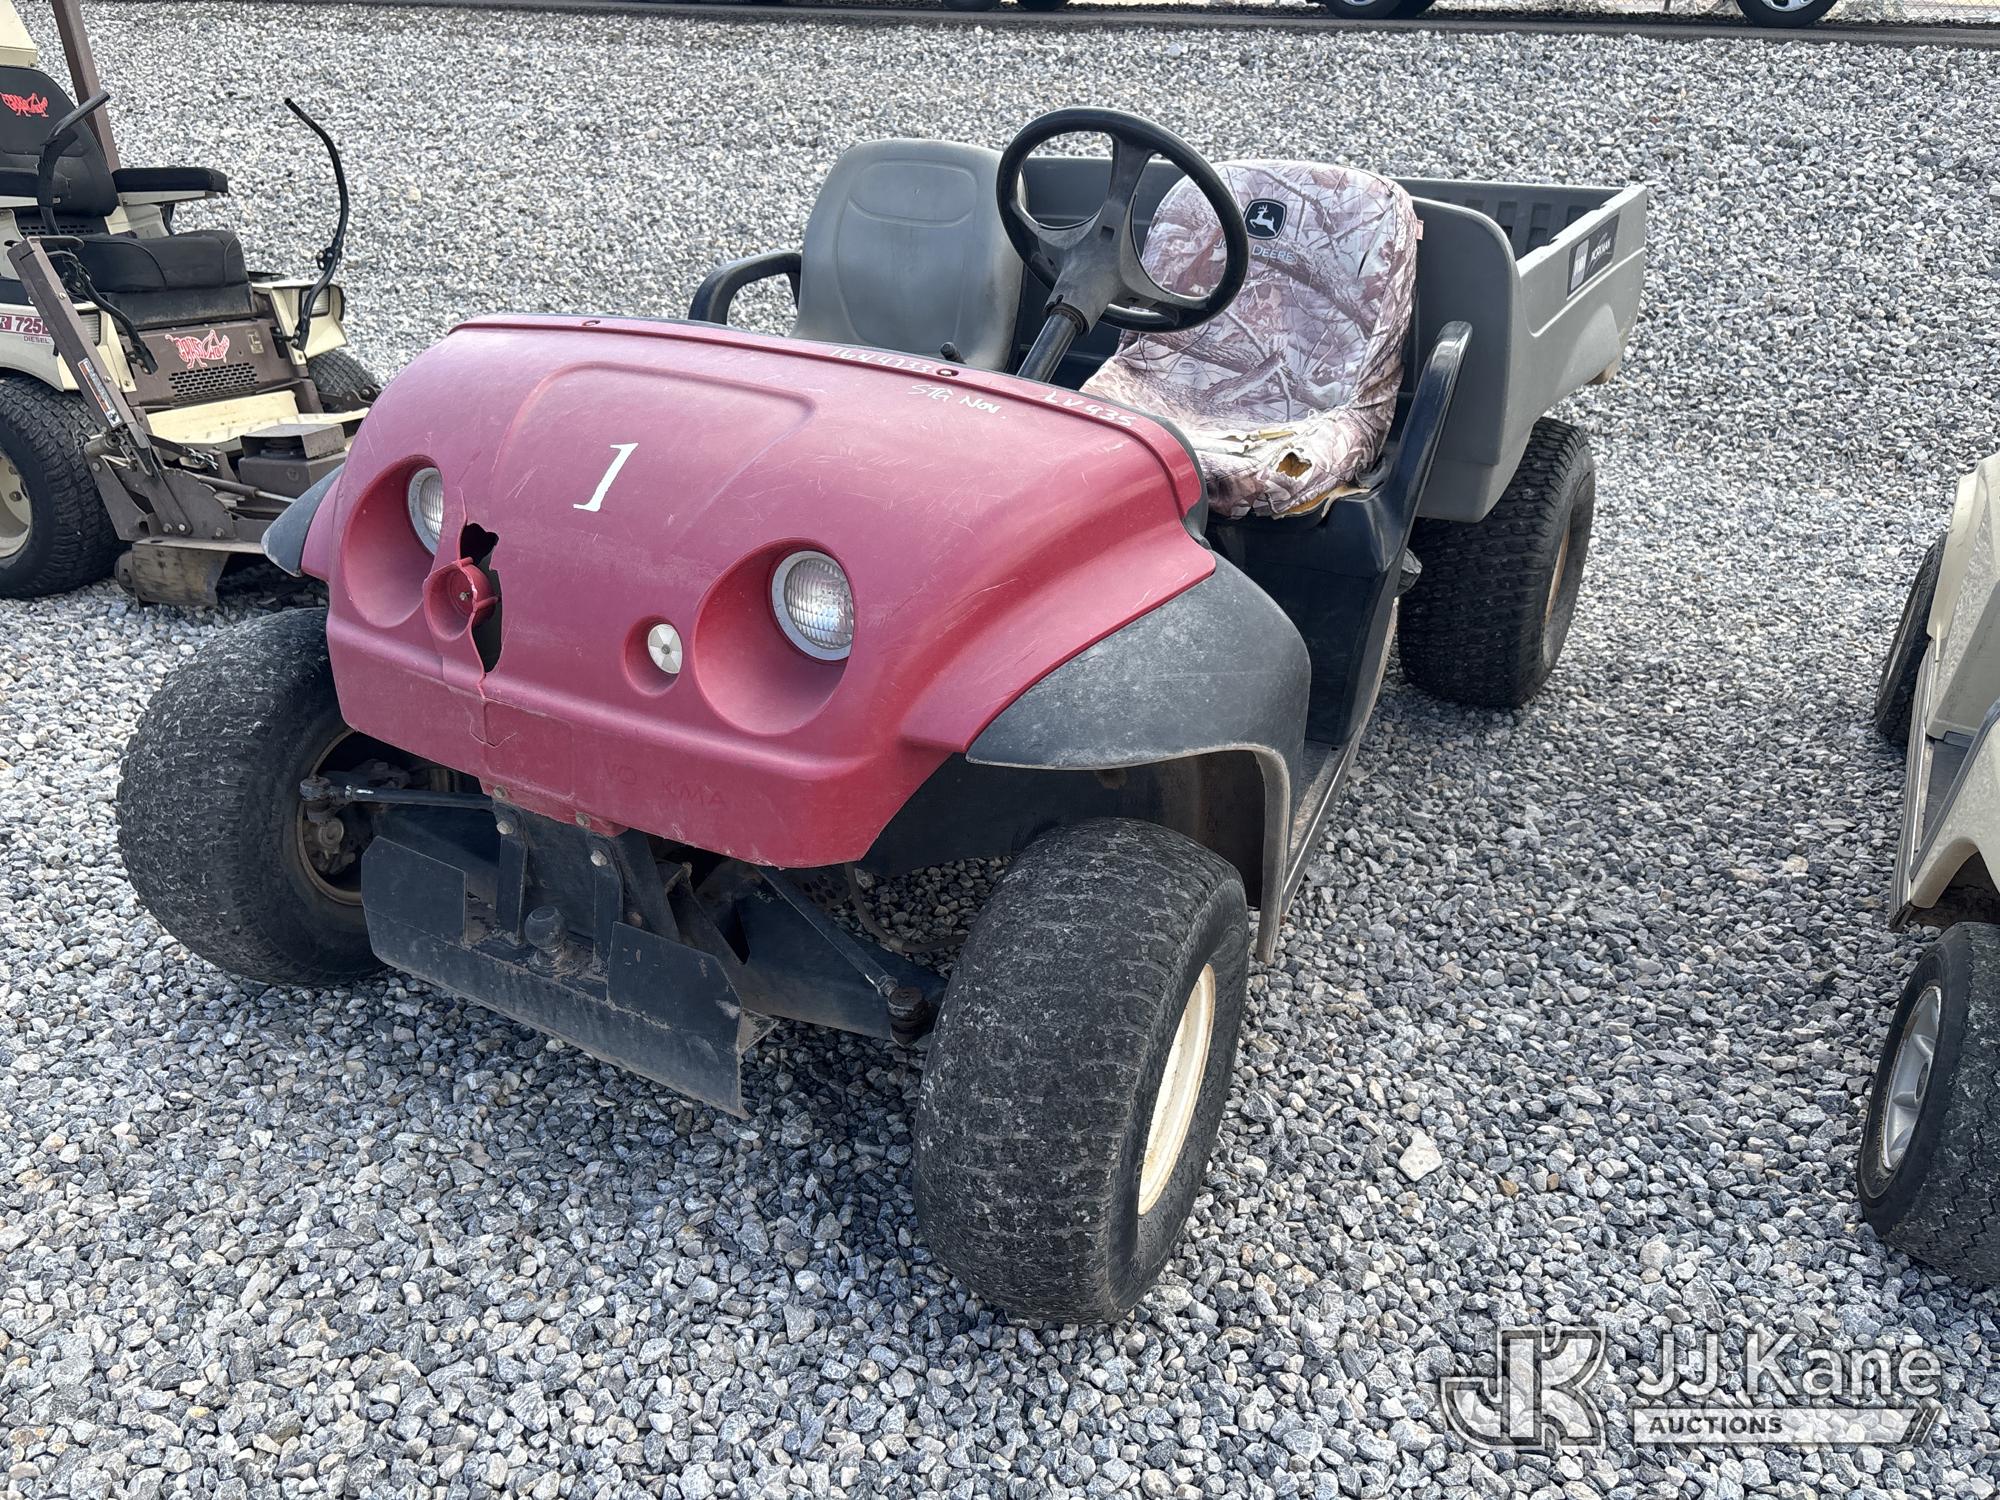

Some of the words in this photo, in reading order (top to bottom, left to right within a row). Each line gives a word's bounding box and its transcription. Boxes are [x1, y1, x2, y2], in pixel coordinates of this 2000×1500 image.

[1251, 244, 1298, 265] DEERE
[24, 335, 50, 344] DIESEL
[573, 442, 640, 512] 1
